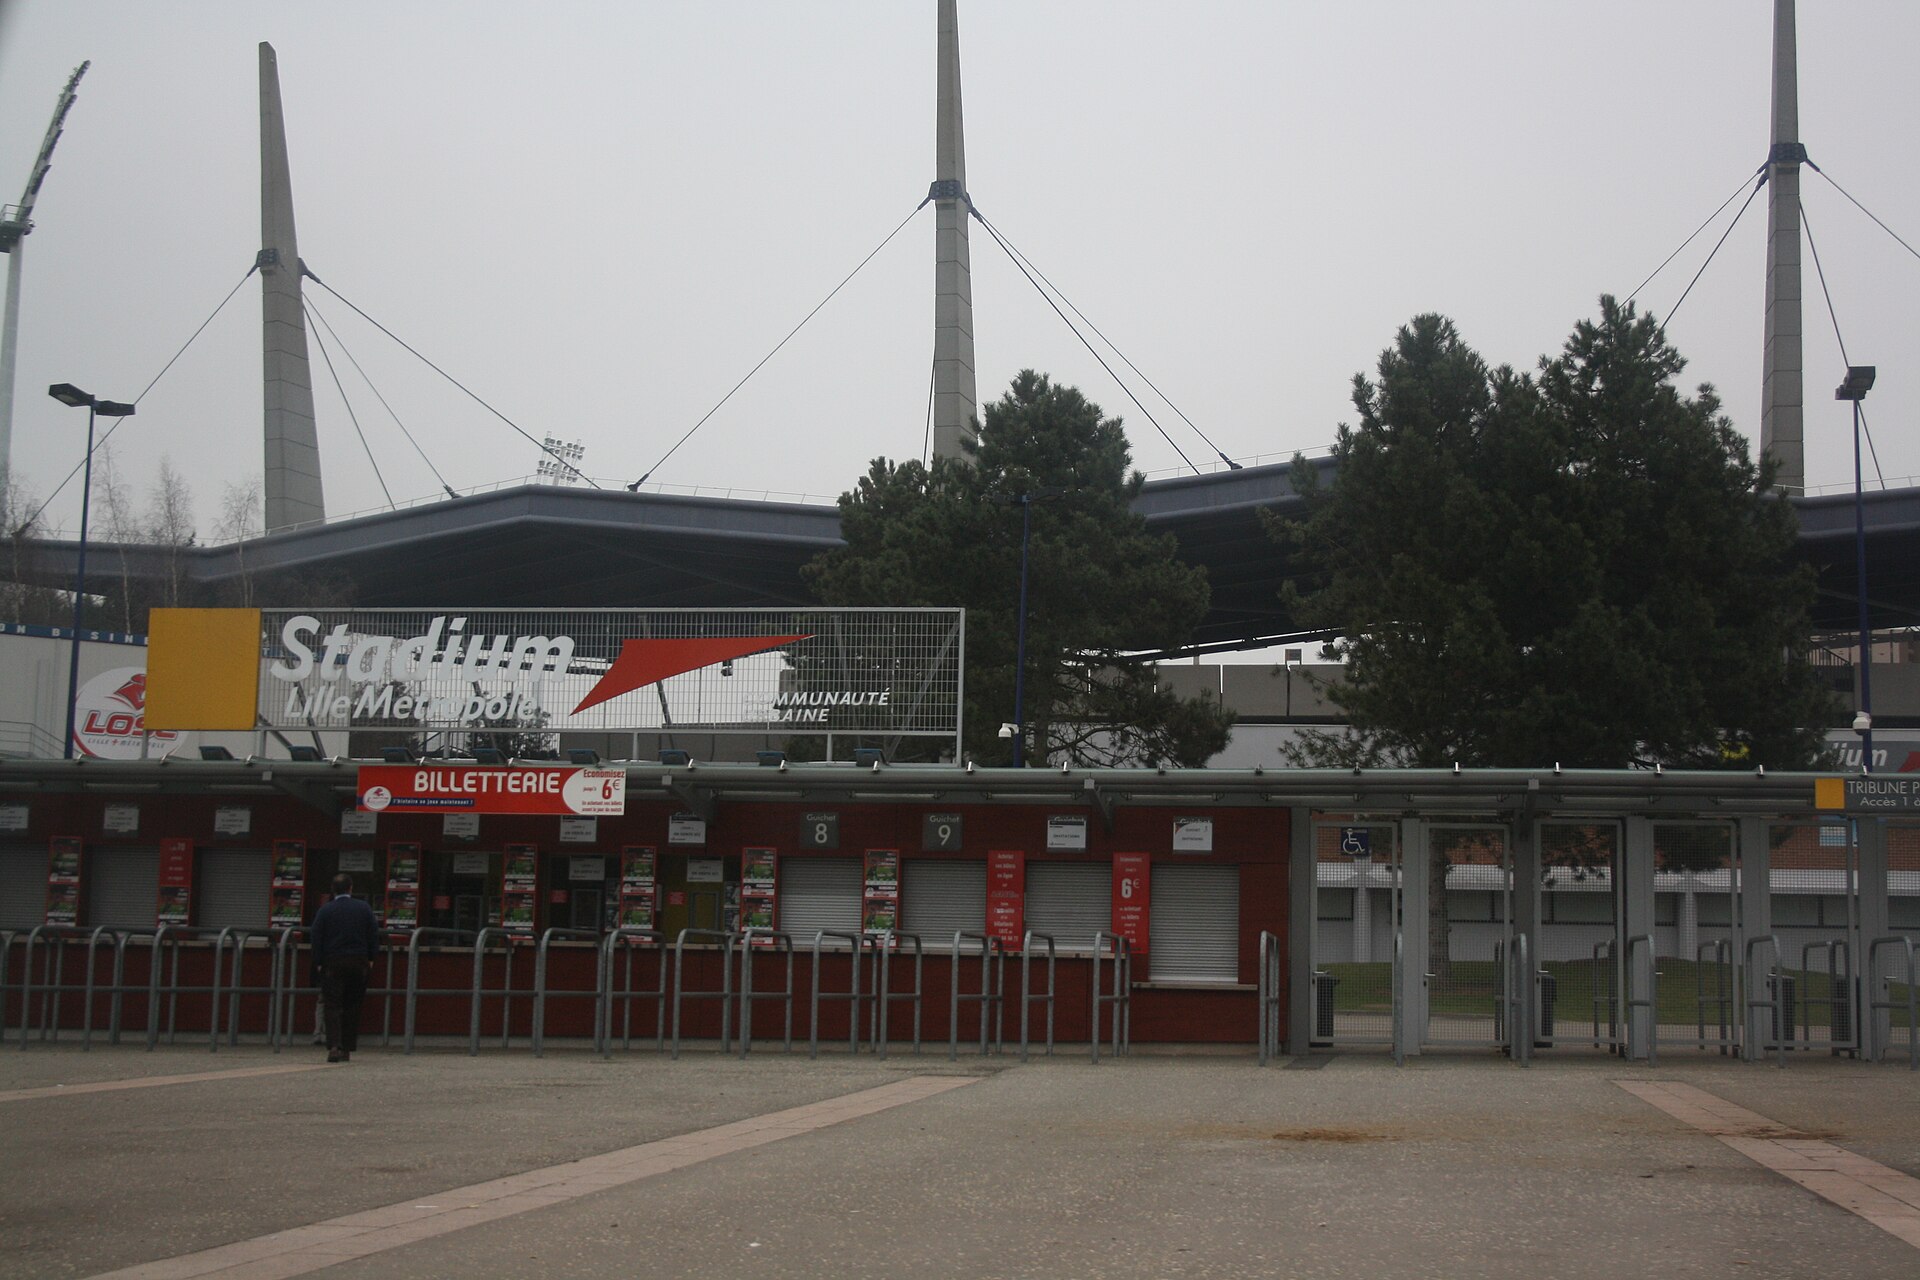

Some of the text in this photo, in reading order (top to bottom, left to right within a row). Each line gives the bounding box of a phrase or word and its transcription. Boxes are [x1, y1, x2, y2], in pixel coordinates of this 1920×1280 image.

[270, 615, 575, 682] Stadium
[284, 685, 351, 719] Lille
[414, 771, 560, 793] BILLETTERIE
[1847, 781, 1907, 794] TRIBUNE
[1860, 796, 1896, 806] Accès
[1902, 797, 1907, 806] 1
[929, 815, 960, 823] Guichet
[815, 823, 828, 843] 8
[938, 825, 951, 846] 9
